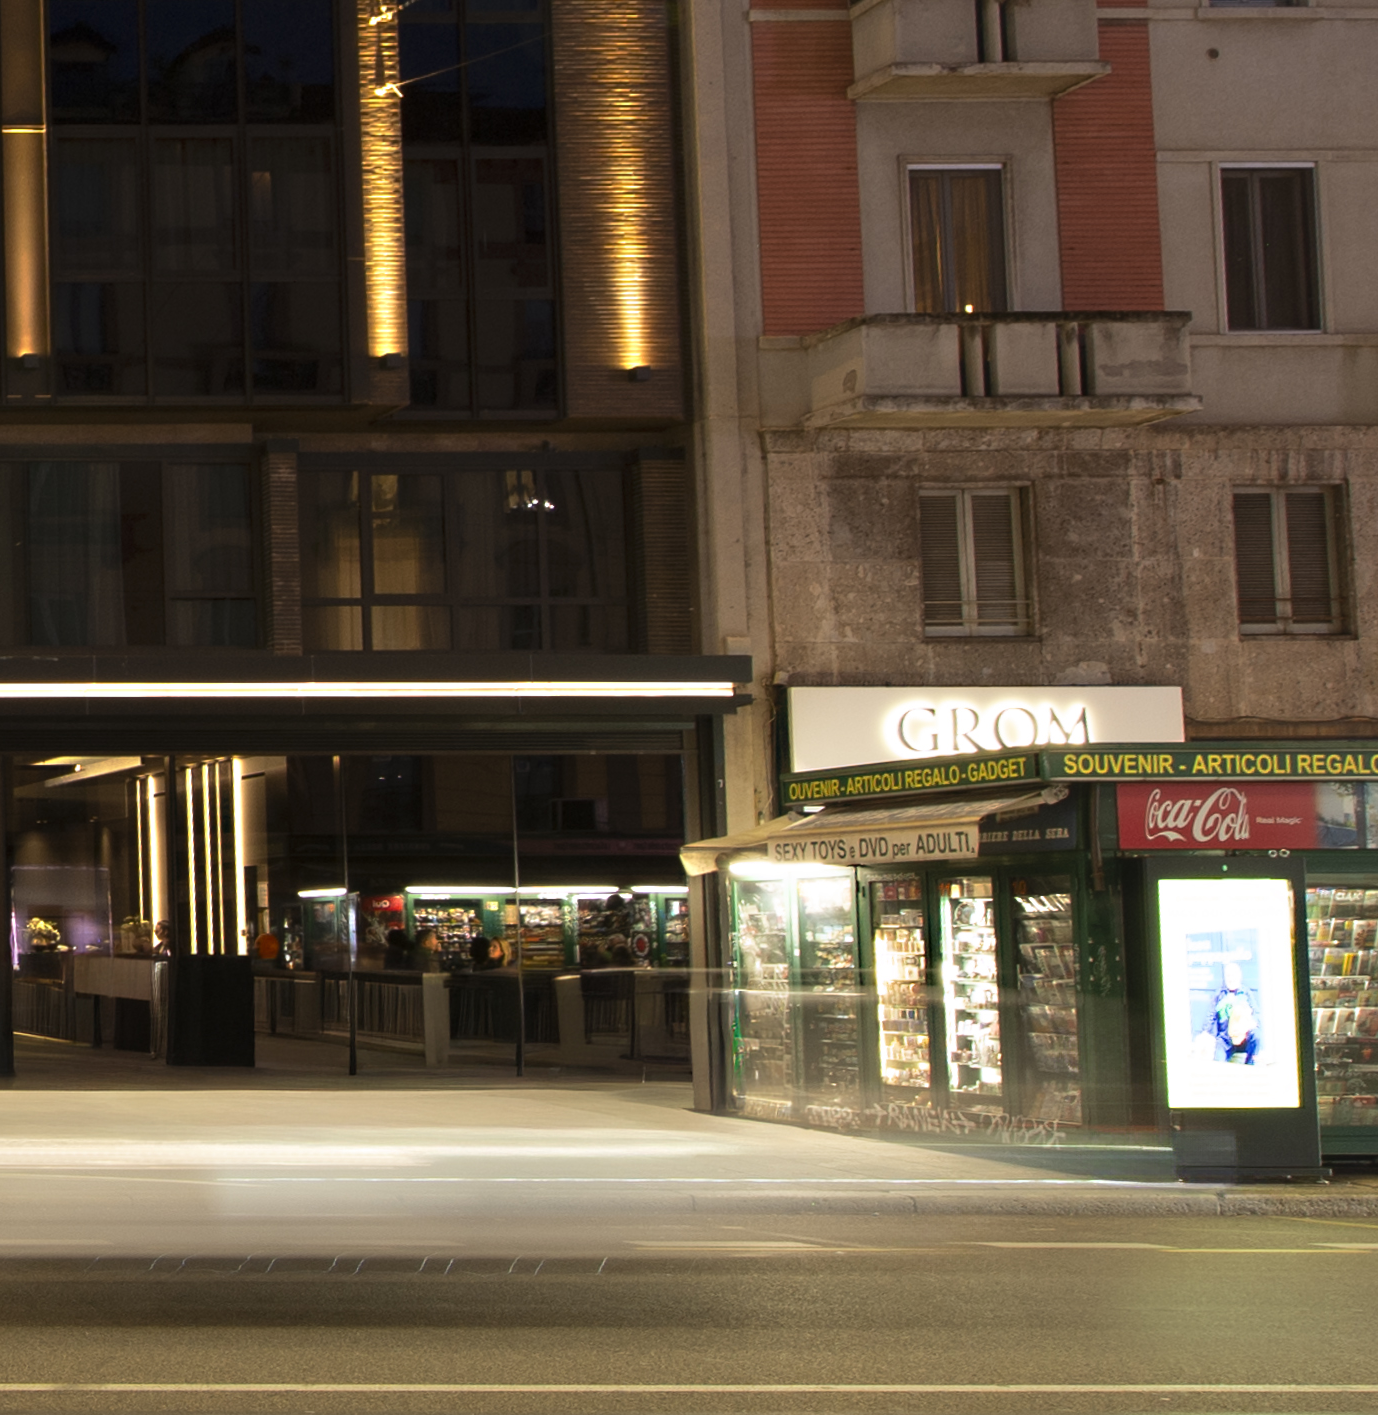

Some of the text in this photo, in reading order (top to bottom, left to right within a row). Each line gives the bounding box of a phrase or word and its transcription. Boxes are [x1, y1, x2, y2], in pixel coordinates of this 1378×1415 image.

[898, 707, 1090, 751] GROM
[1063, 754, 1174, 774] SOUVENIR
[1192, 754, 1291, 774] ARTICOLI
[1145, 787, 1250, 842] Coca-Cola
[774, 842, 807, 862] SEXY
[810, 839, 846, 860] TOYS
[849, 846, 856, 859] e
[859, 836, 888, 858] DVD
[892, 843, 911, 859] per
